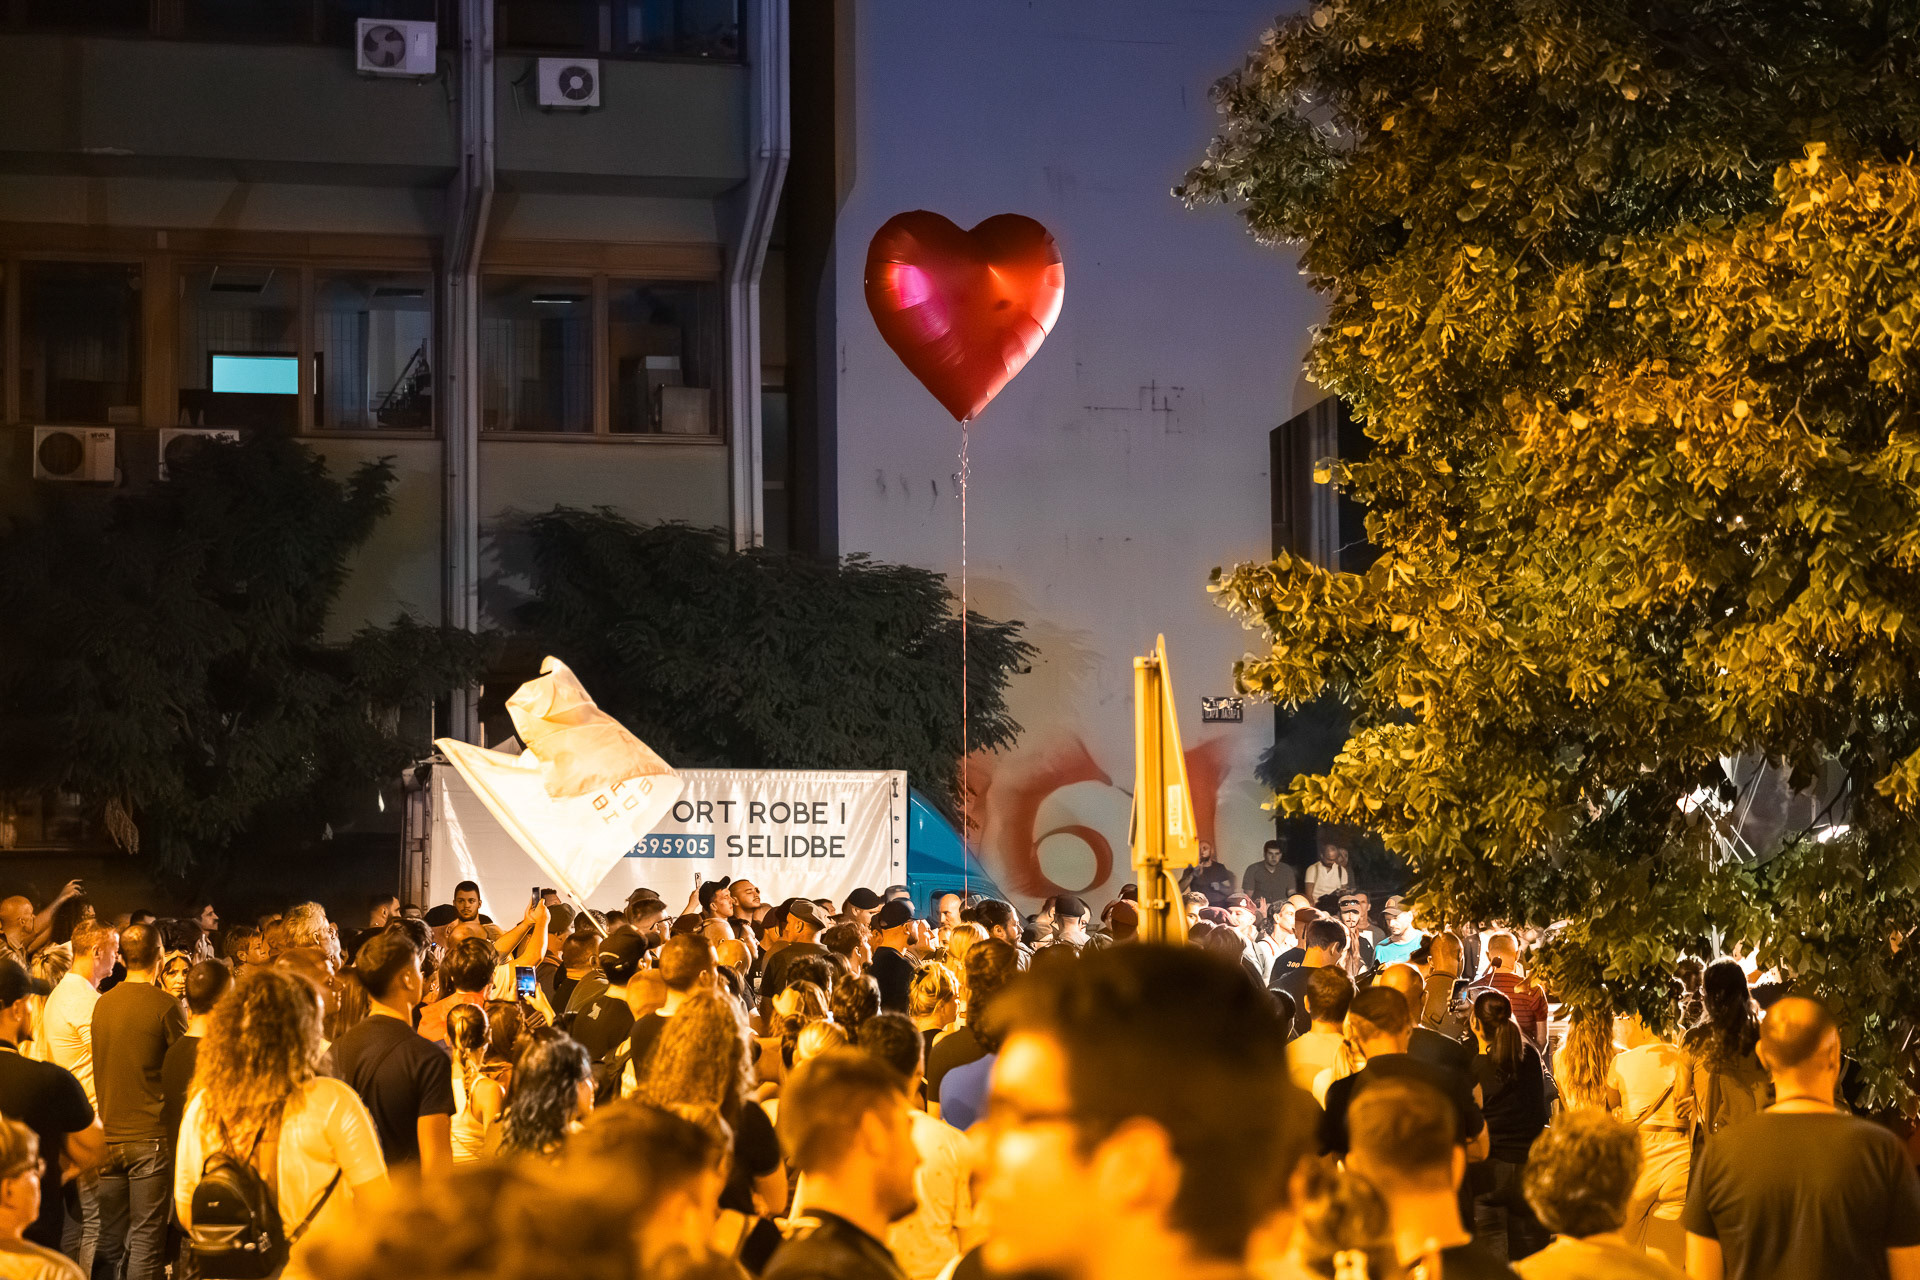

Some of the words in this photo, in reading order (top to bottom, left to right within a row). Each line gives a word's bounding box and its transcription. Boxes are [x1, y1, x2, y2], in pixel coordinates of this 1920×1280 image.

[749, 801, 828, 824] ROBE
[841, 802, 845, 824] I
[726, 835, 845, 857] SELIDBE
